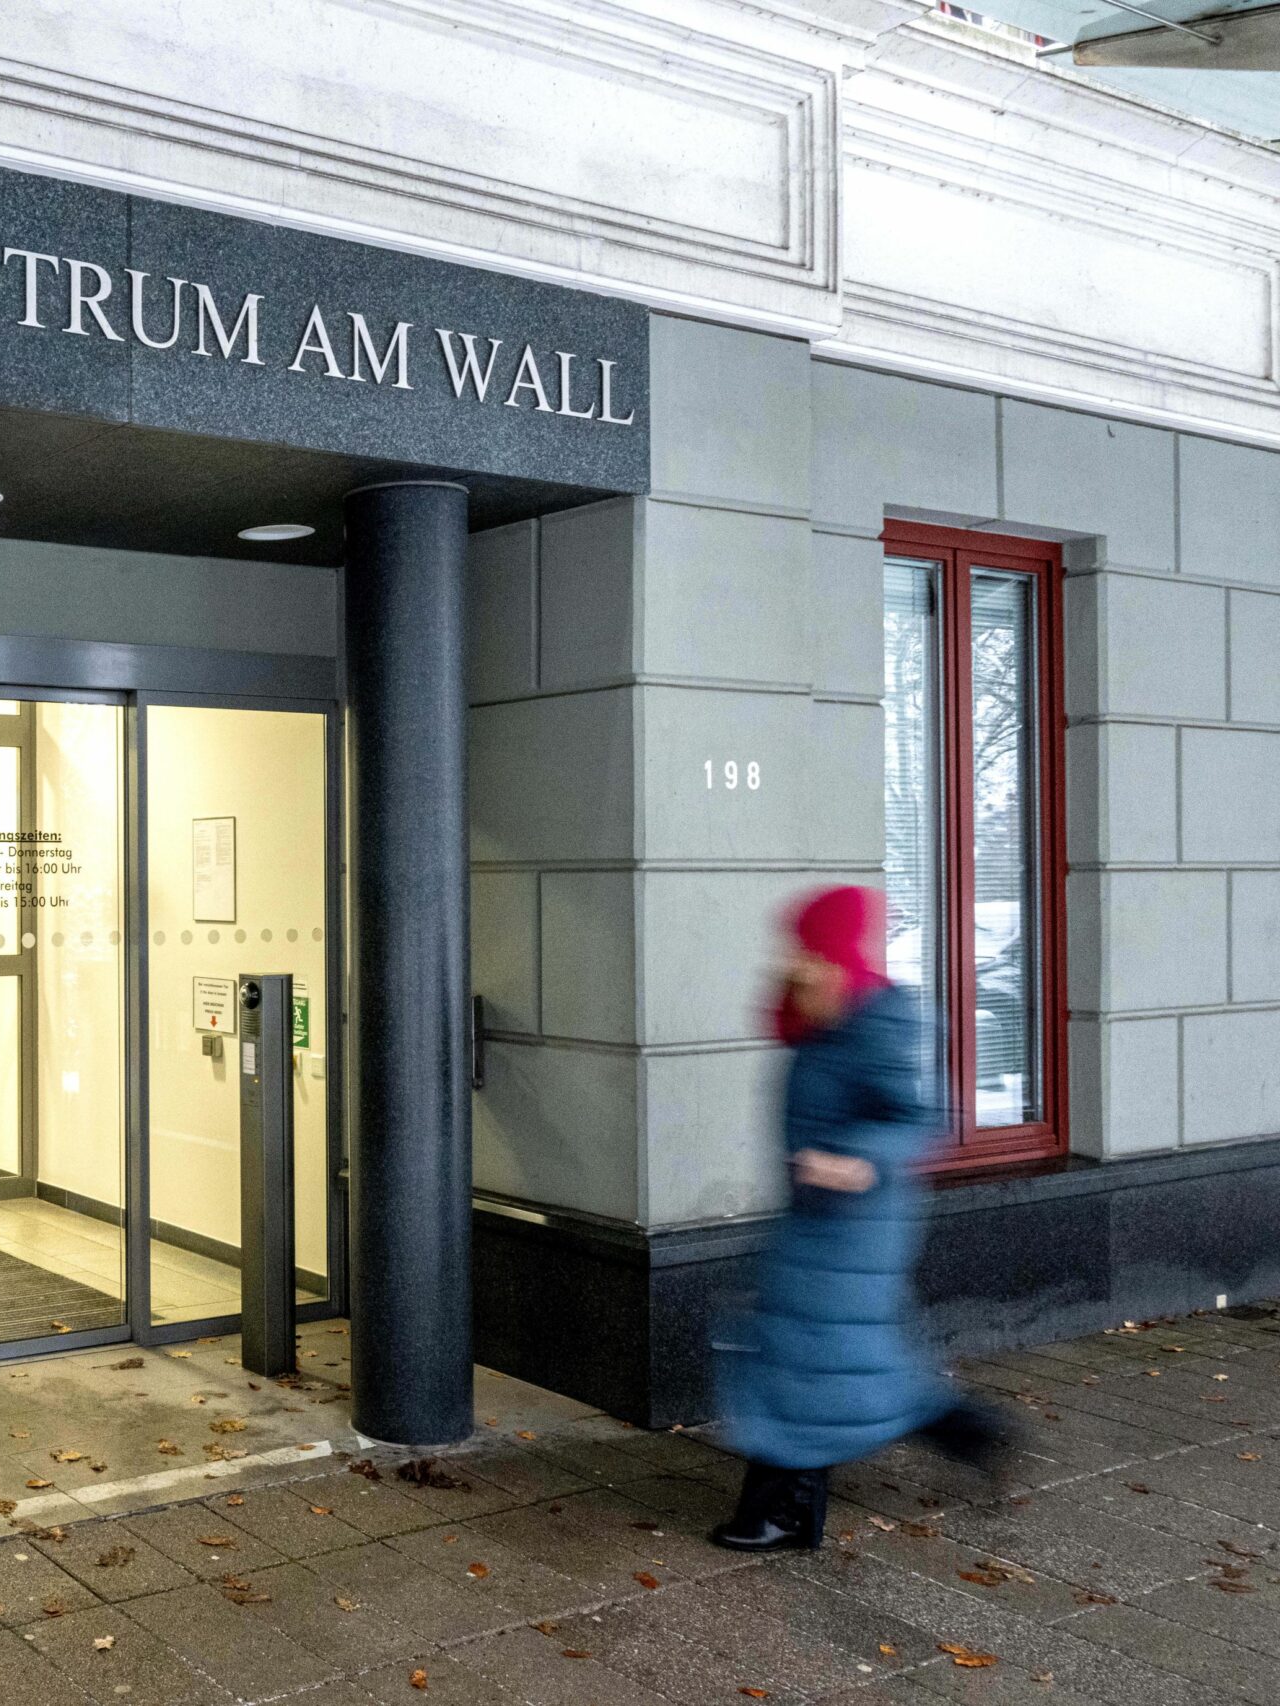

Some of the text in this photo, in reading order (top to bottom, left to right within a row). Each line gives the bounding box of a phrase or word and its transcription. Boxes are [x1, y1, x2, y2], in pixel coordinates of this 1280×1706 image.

[288, 304, 414, 390] AM
[435, 328, 635, 425] WALL
[704, 759, 760, 790] 198
[8, 846, 72, 860] Donnerstag
[5, 863, 21, 875] bis
[26, 863, 58, 874] 16:00
[61, 863, 82, 874] Uhr
[15, 896, 46, 908] 15:00
[50, 896, 70, 907] Uhr
